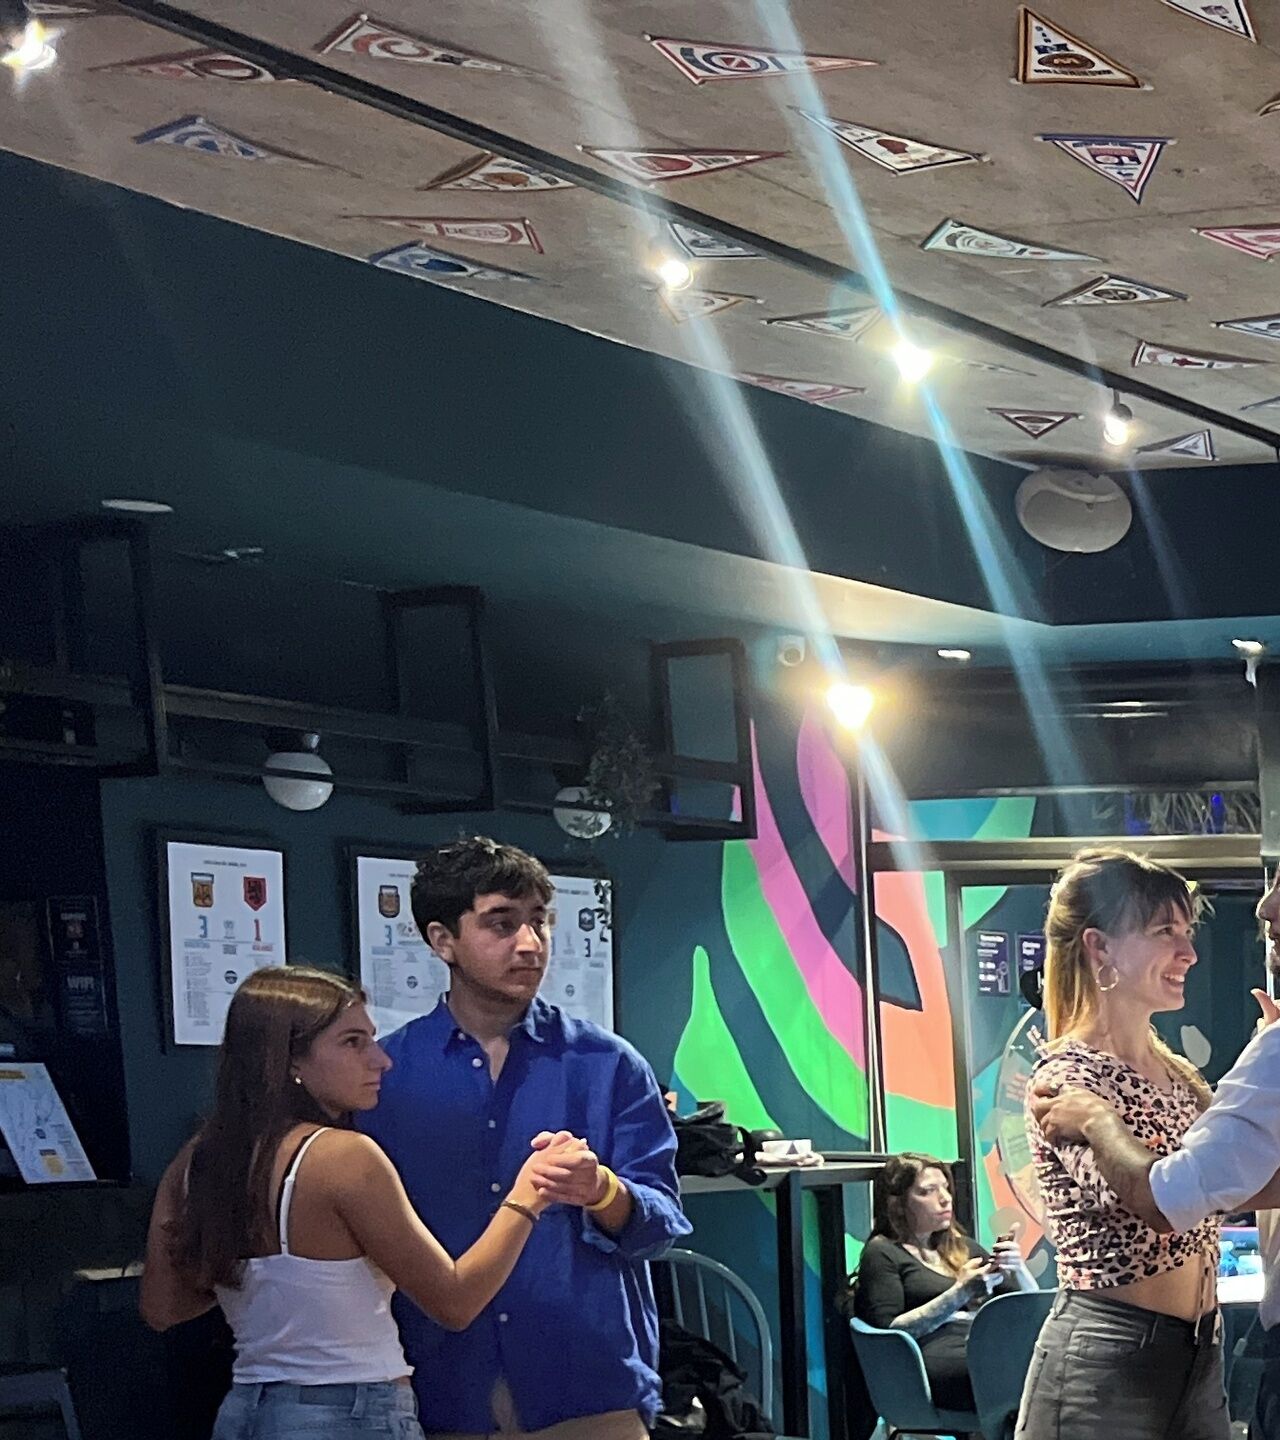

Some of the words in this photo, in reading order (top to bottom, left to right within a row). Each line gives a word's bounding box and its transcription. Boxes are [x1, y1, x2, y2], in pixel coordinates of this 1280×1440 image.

[198, 914, 208, 939] 3
[254, 919, 261, 941] 1
[385, 925, 392, 946] 3
[584, 938, 591, 958] 3
